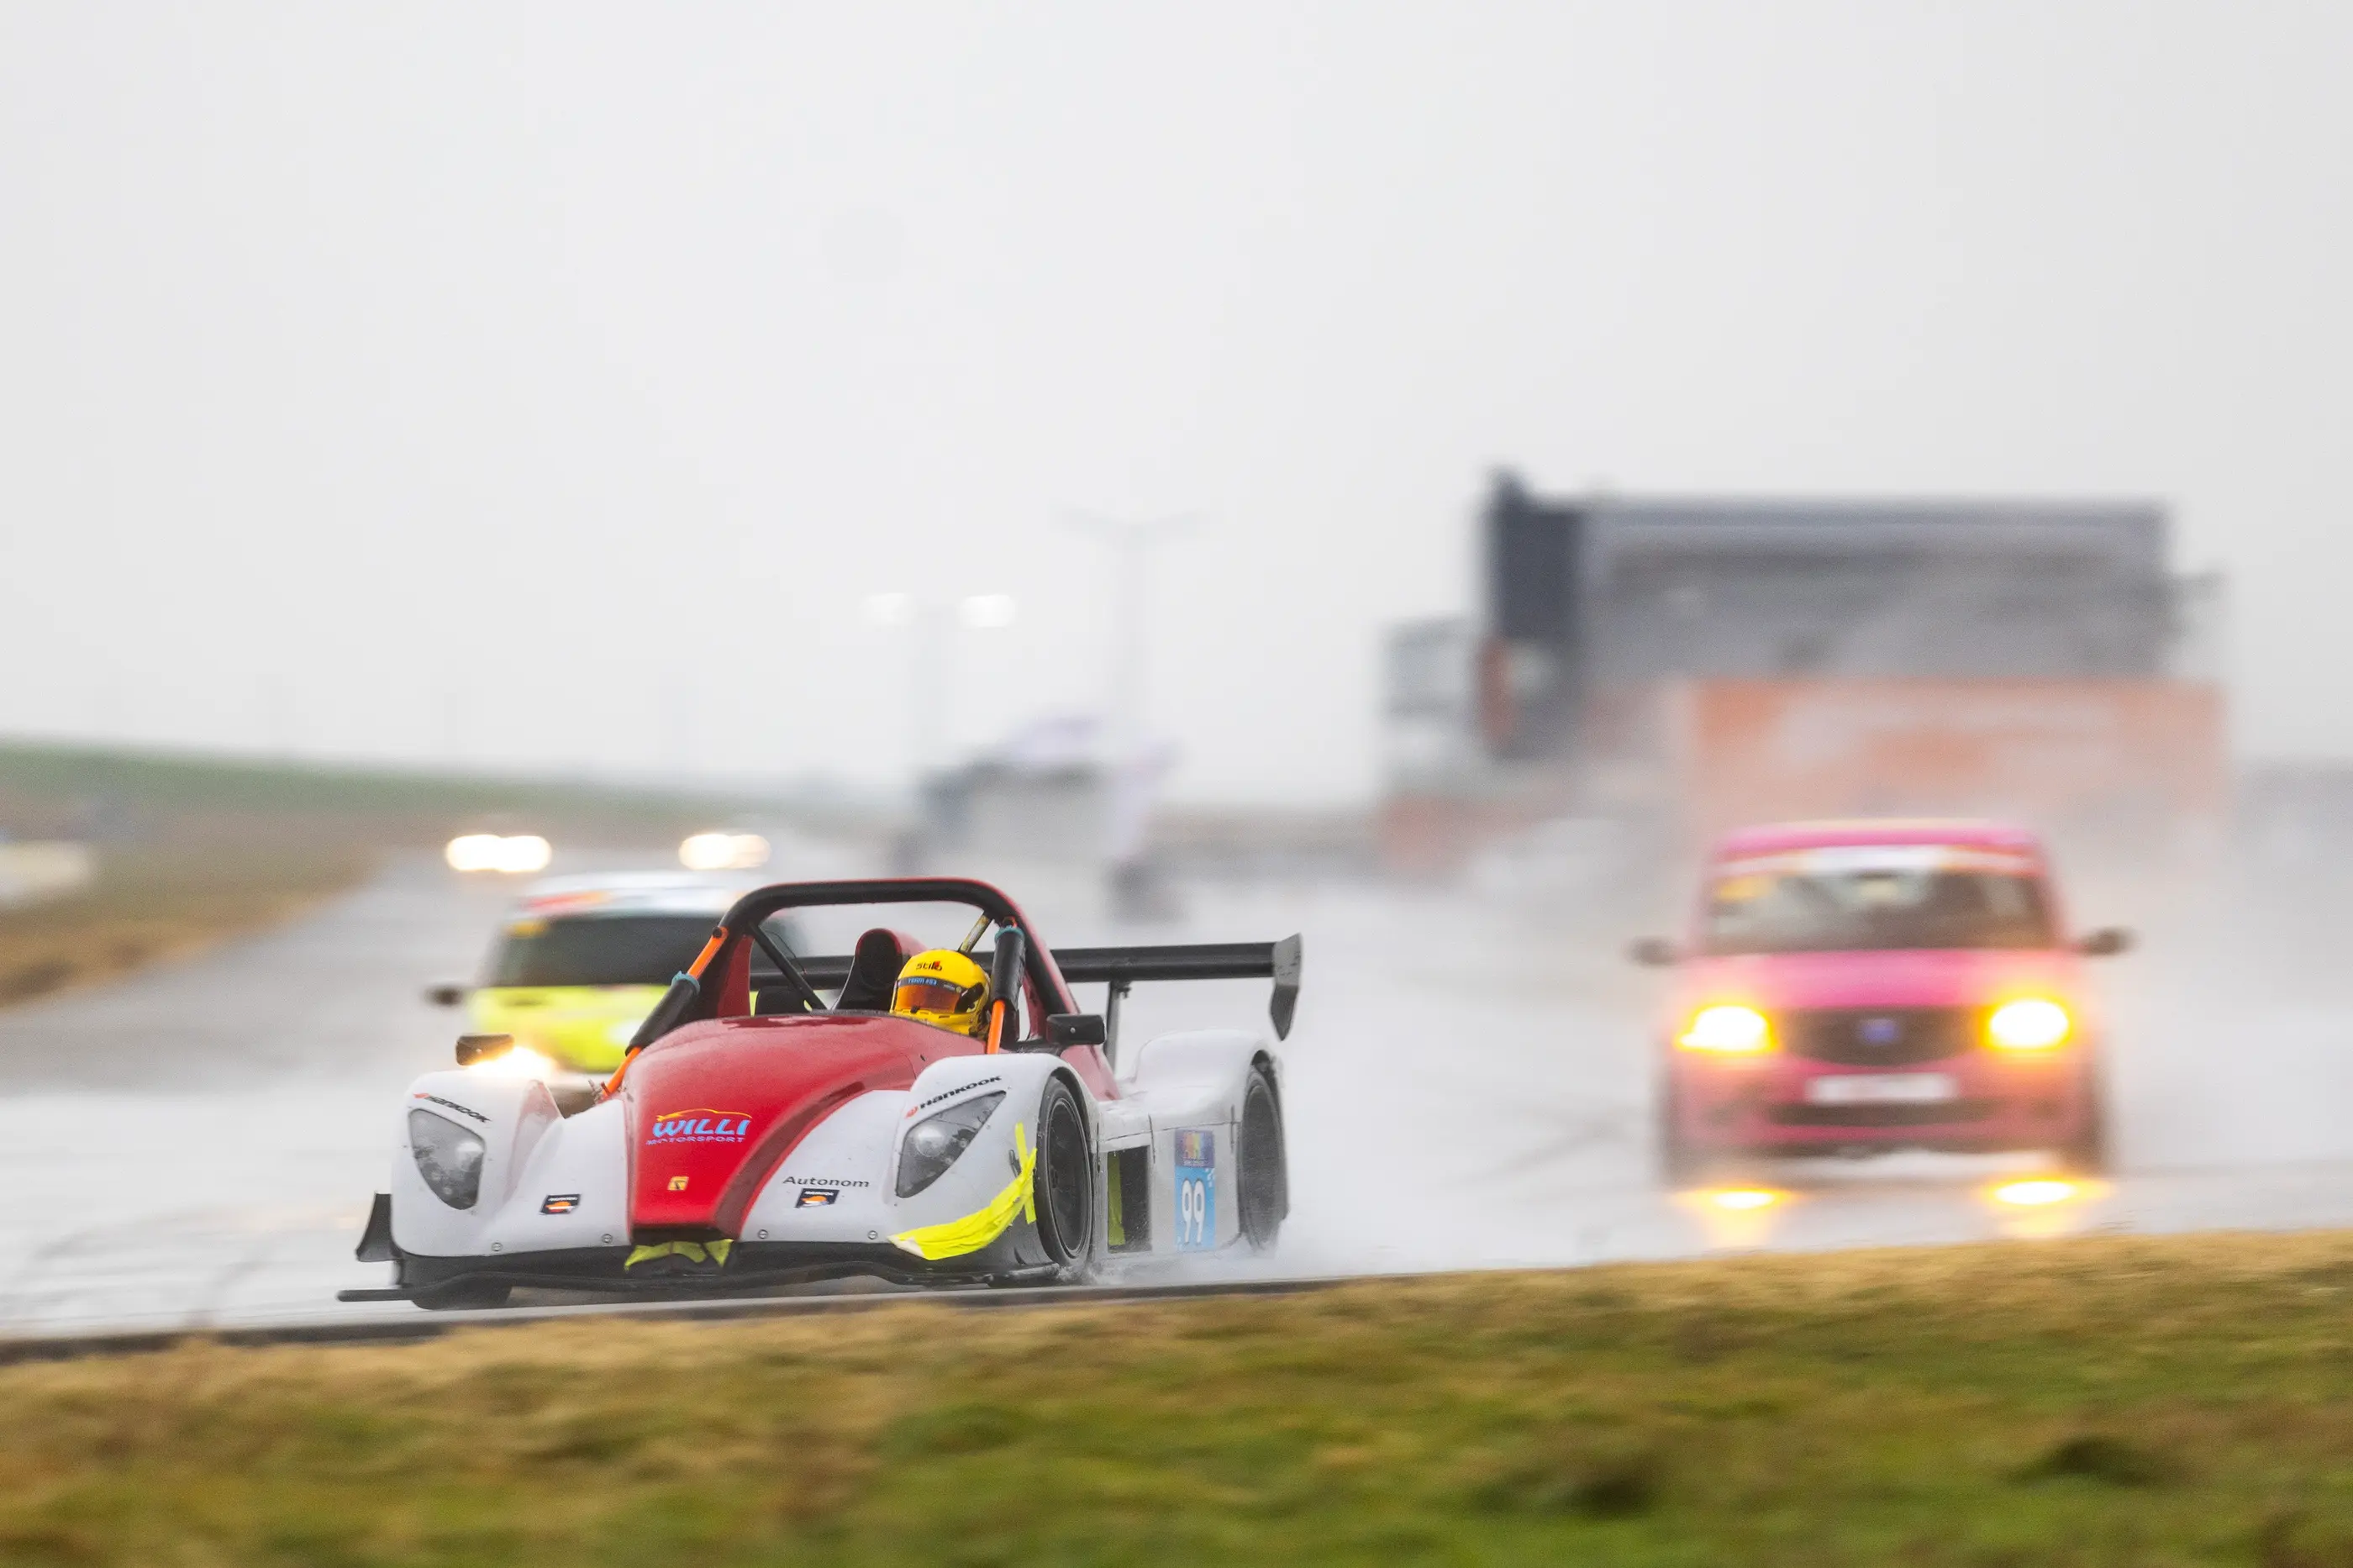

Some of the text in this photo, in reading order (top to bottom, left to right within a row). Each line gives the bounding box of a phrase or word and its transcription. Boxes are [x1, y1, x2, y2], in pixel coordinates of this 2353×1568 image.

[652, 1118, 751, 1137] WILLI
[645, 1136, 745, 1145] MOTORSPORT
[782, 1176, 870, 1187] Autonom
[1182, 1177, 1205, 1244] 99
